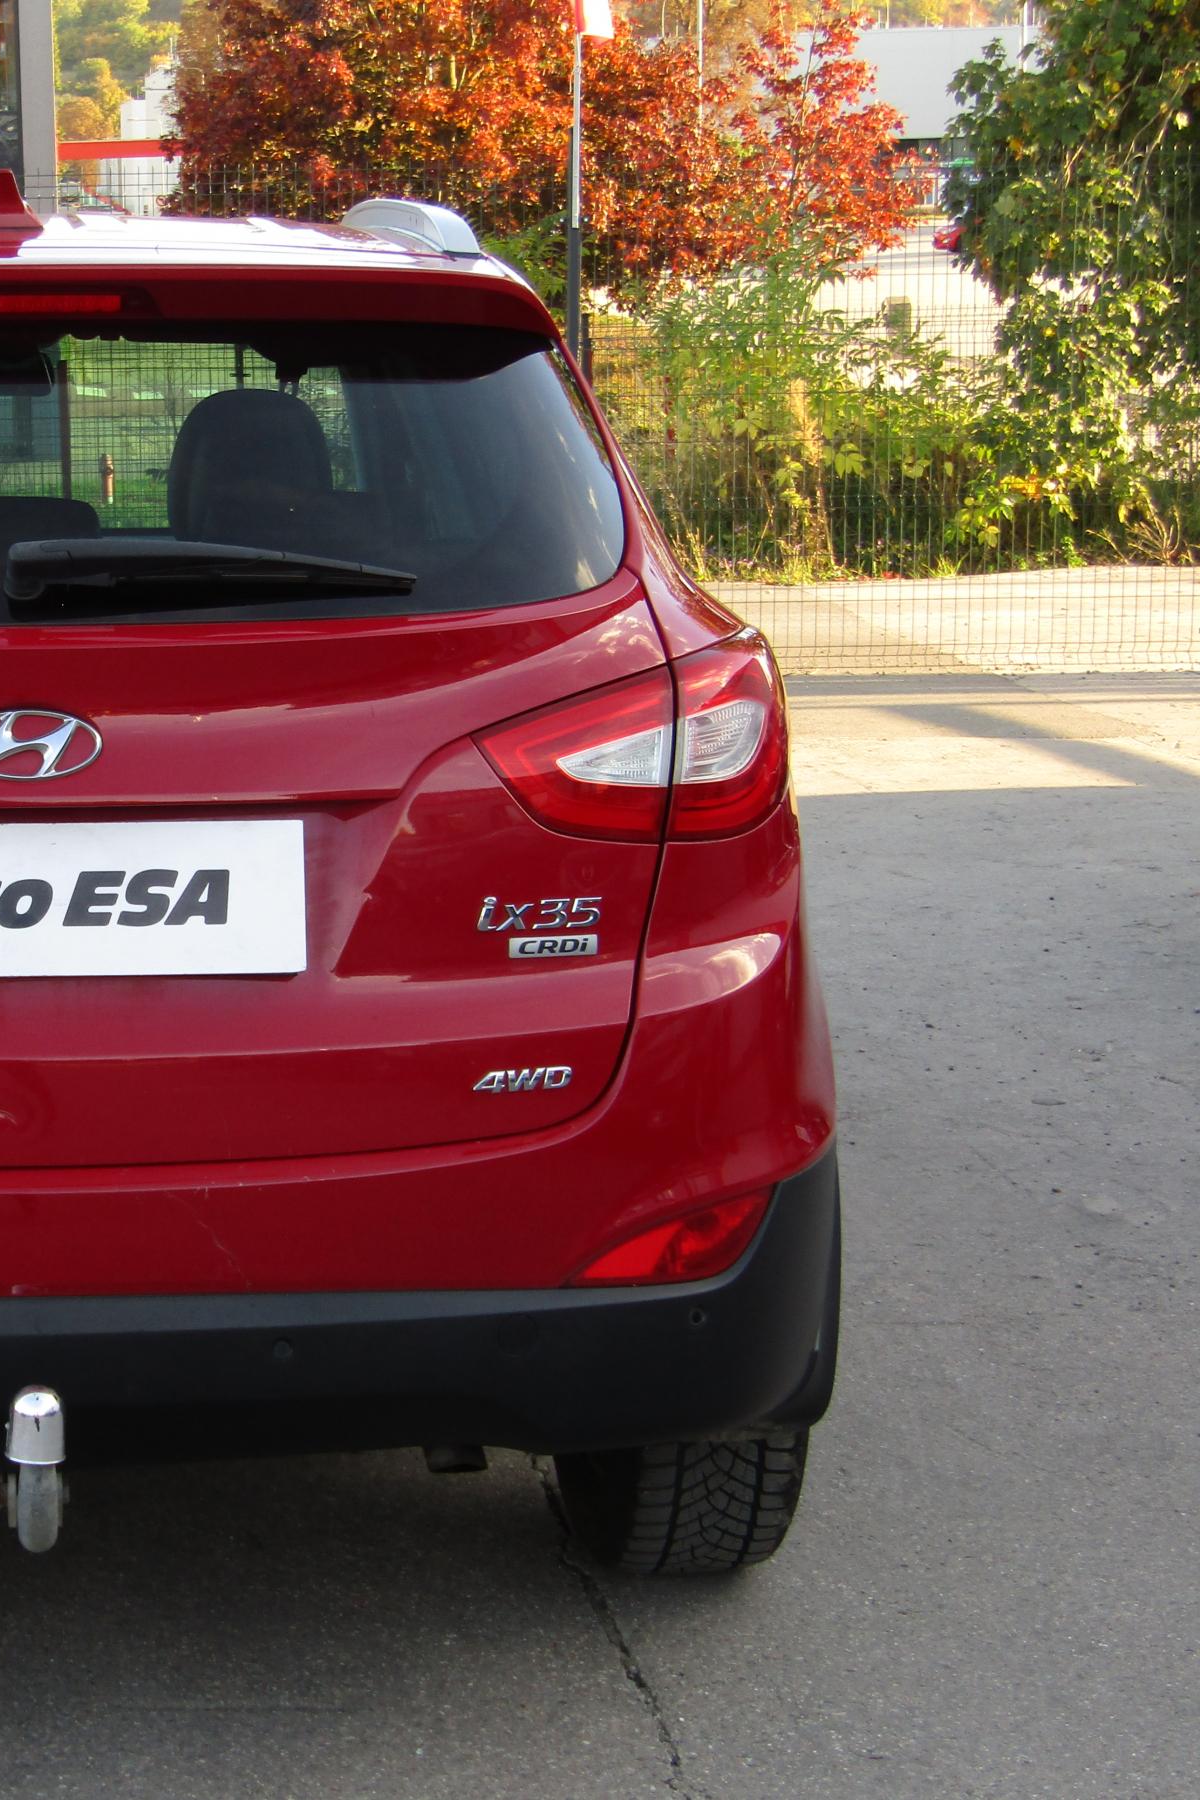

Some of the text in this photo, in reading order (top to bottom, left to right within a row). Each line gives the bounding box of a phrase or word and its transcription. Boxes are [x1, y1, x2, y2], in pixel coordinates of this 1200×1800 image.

[62, 869, 230, 927] ESA
[477, 896, 603, 931] ix35
[518, 937, 589, 955] CRDi
[472, 1065, 572, 1093] 4WD
